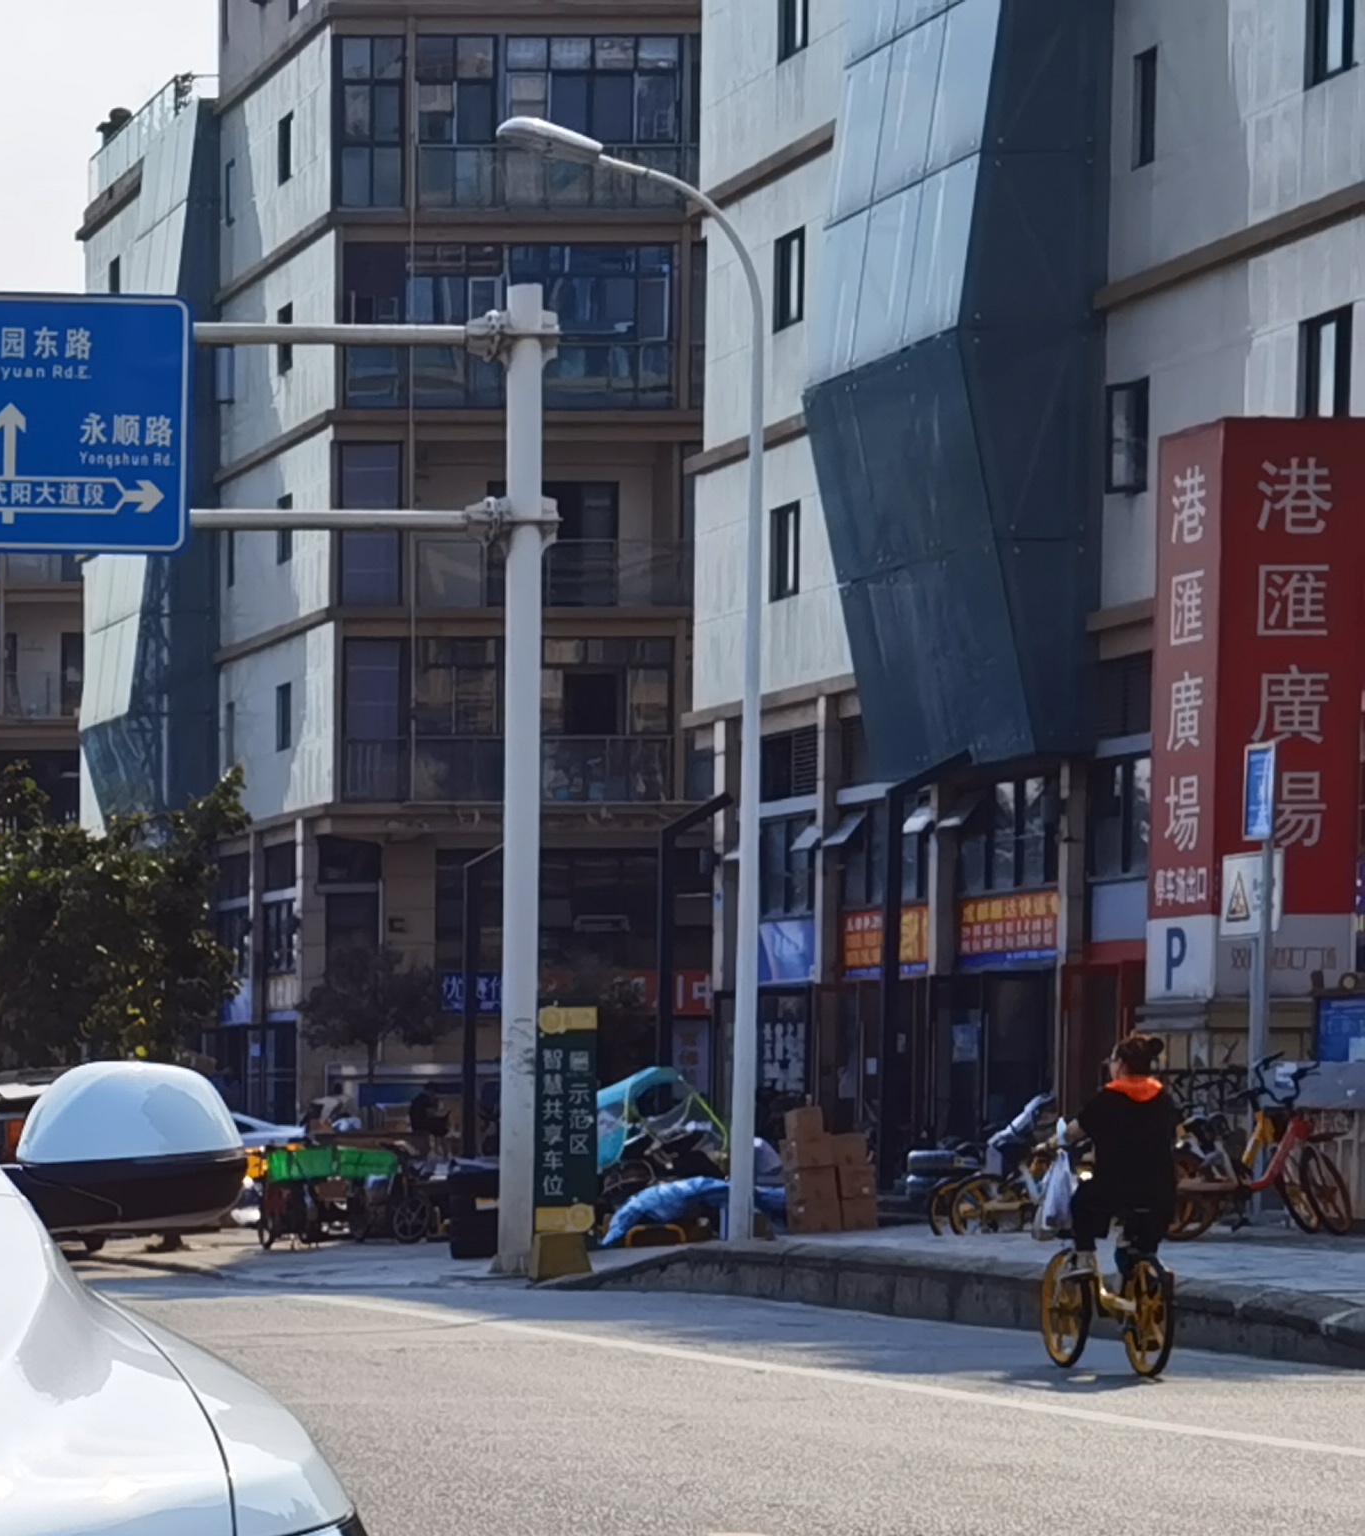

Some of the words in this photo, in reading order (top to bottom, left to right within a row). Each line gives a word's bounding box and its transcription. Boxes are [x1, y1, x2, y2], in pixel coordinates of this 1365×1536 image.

[79, 413, 174, 447] 永顺路
[79, 452, 149, 469] Yongshun
[153, 453, 175, 467] Rd.
[1164, 464, 1207, 852] 港匯廣場
[1165, 927, 1187, 991] P
[541, 1048, 564, 1197] 智慧共享车位
